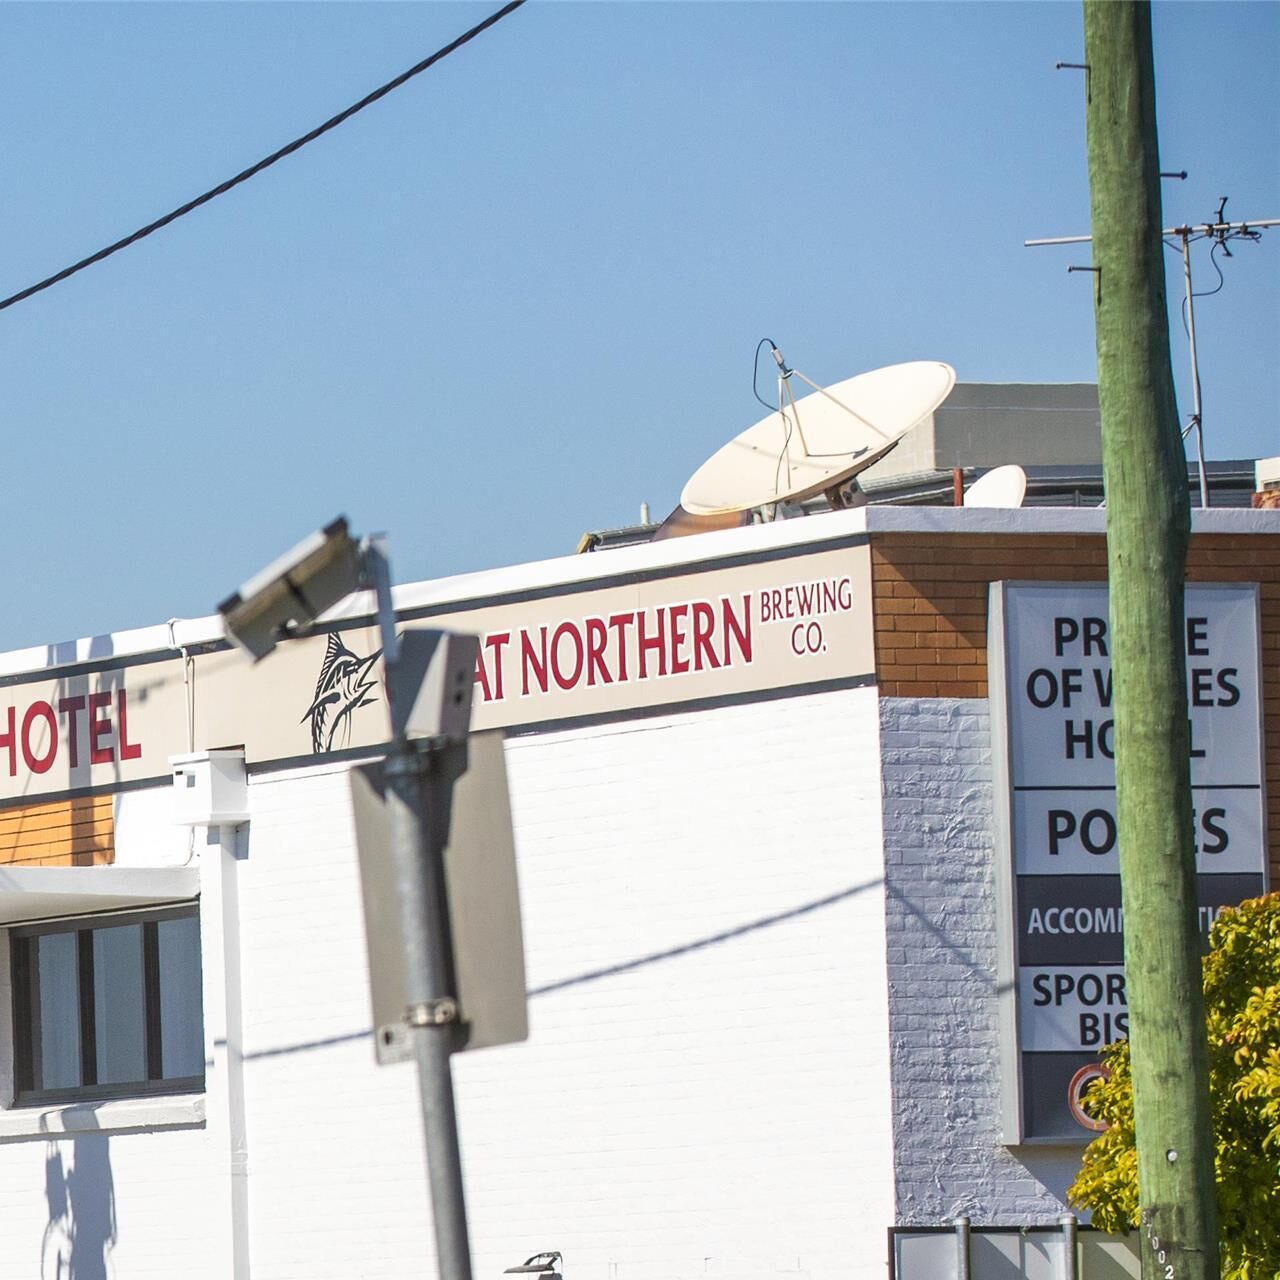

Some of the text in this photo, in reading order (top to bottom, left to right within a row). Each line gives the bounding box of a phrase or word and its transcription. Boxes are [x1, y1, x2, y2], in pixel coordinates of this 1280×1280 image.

[760, 577, 852, 623] BREWING
[521, 595, 753, 696] NORTHERN
[791, 622, 827, 655] CO.
[1026, 668, 1082, 708] OF
[1033, 973, 1127, 1006] SPOR
